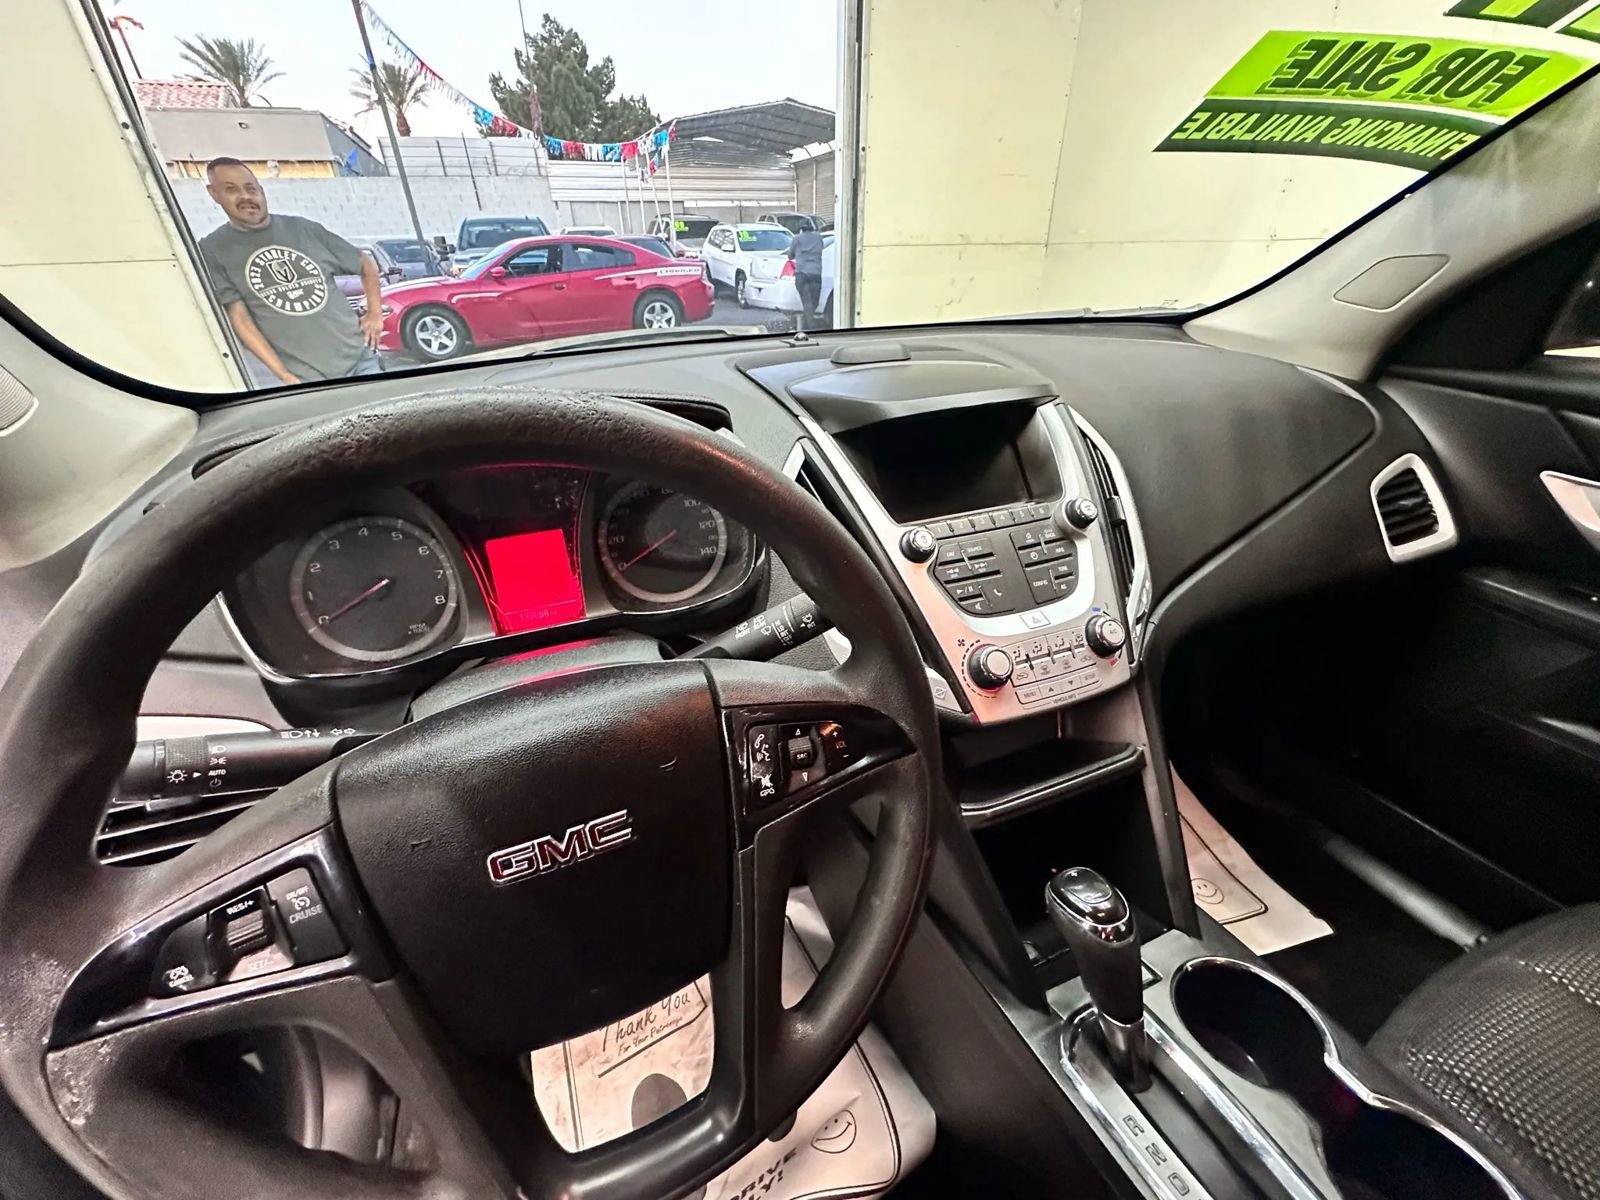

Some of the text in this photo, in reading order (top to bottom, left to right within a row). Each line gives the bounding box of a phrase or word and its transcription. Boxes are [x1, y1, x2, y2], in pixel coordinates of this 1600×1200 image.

[254, 249, 297, 266] STANLEY
[300, 259, 319, 275] CUP
[358, 527, 369, 537] 4
[391, 531, 403, 541] 5
[328, 540, 341, 550] 3
[418, 546, 430, 556] 6
[309, 562, 321, 573] 2
[434, 569, 444, 579] 7
[434, 595, 446, 605] 8
[208, 768, 226, 777] AUTO
[487, 809, 634, 884] GMC
[289, 904, 323, 924] CRUISE
